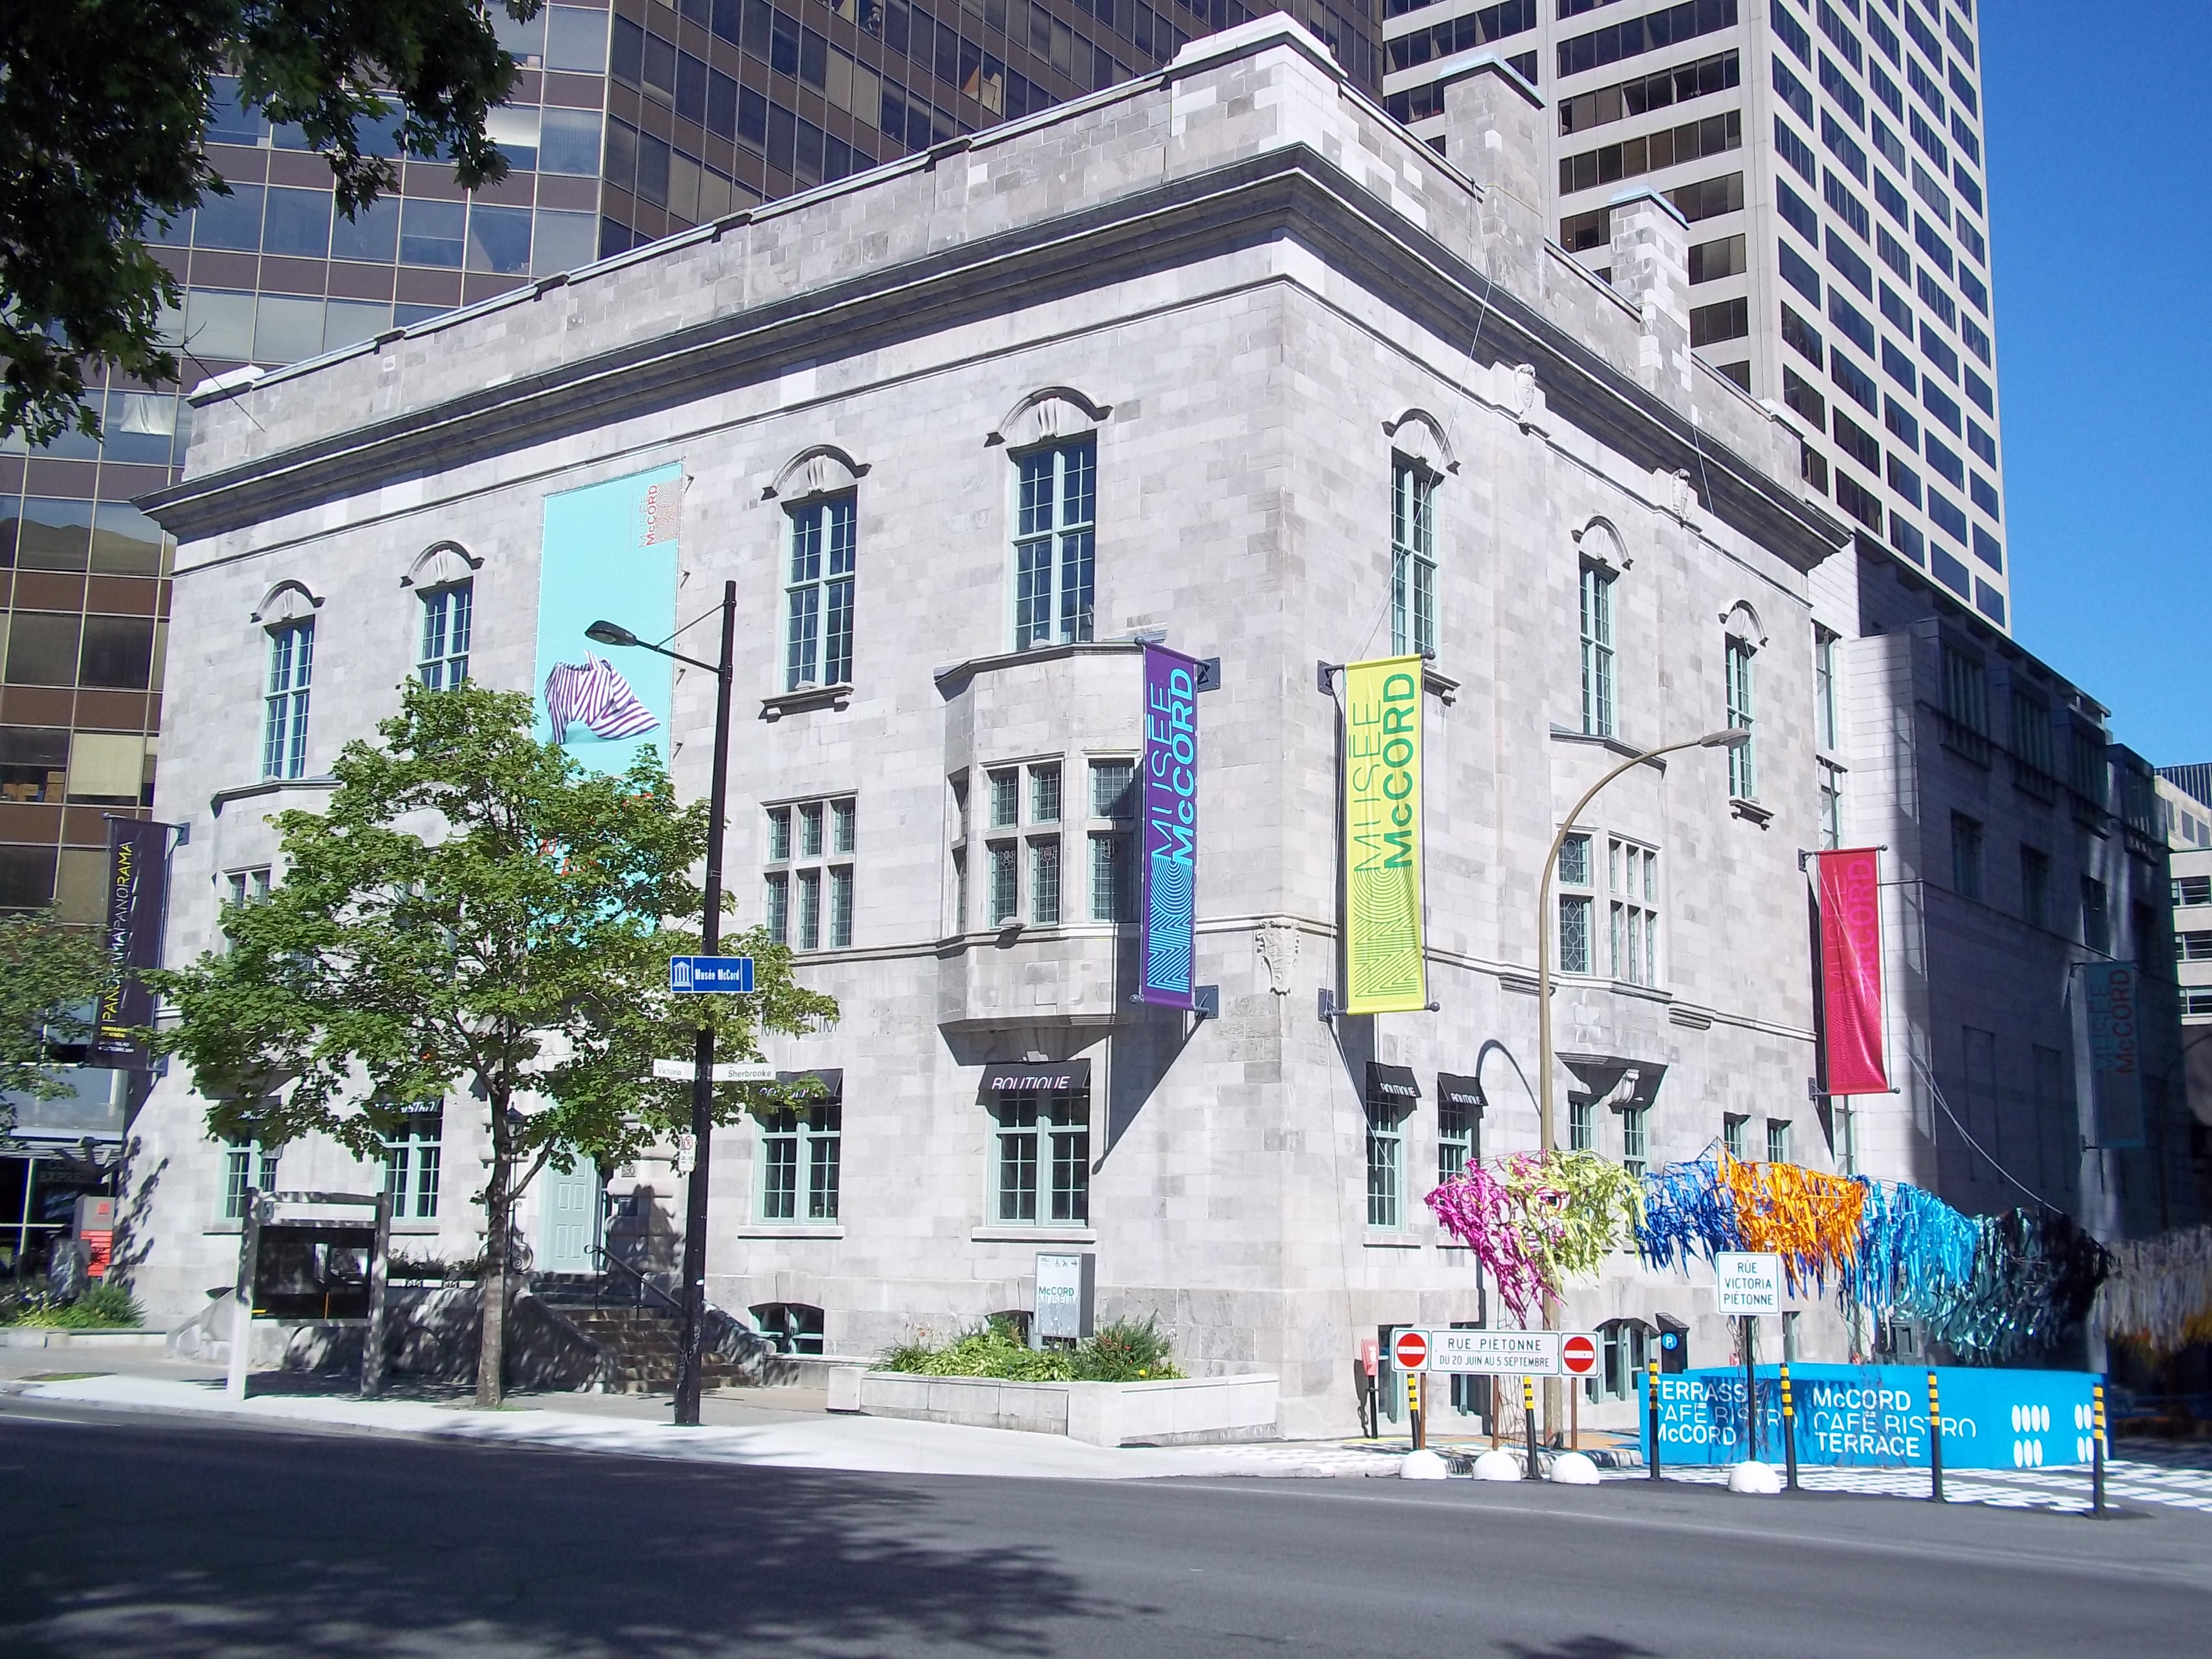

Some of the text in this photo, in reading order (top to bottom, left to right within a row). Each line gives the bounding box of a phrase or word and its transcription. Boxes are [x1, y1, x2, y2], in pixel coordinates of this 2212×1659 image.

[646, 485, 657, 546] McCORD
[1170, 668, 1194, 867] McCORD
[1383, 672, 1415, 869] McCORD
[695, 968, 739, 980] Musée McCord
[658, 1066, 682, 1076] Victoria
[728, 1069, 771, 1078] Sherbrooke
[1738, 1261, 1758, 1274] RUE
[1039, 1286, 1074, 1297] McCORD
[1724, 1277, 1772, 1290] VICTORIA
[1448, 1338, 1472, 1349] RUE
[1439, 1355, 1550, 1368] DU 20 JUIN AU 5 SEPTEMBRE
[1657, 1380, 1761, 1405] ERRASS
[1813, 1387, 1912, 1412] McCORD
[1657, 1402, 1708, 1424] AFÉ
[1885, 1414, 1977, 1438] BISRO
[1814, 1431, 1921, 1458] TERRACE
